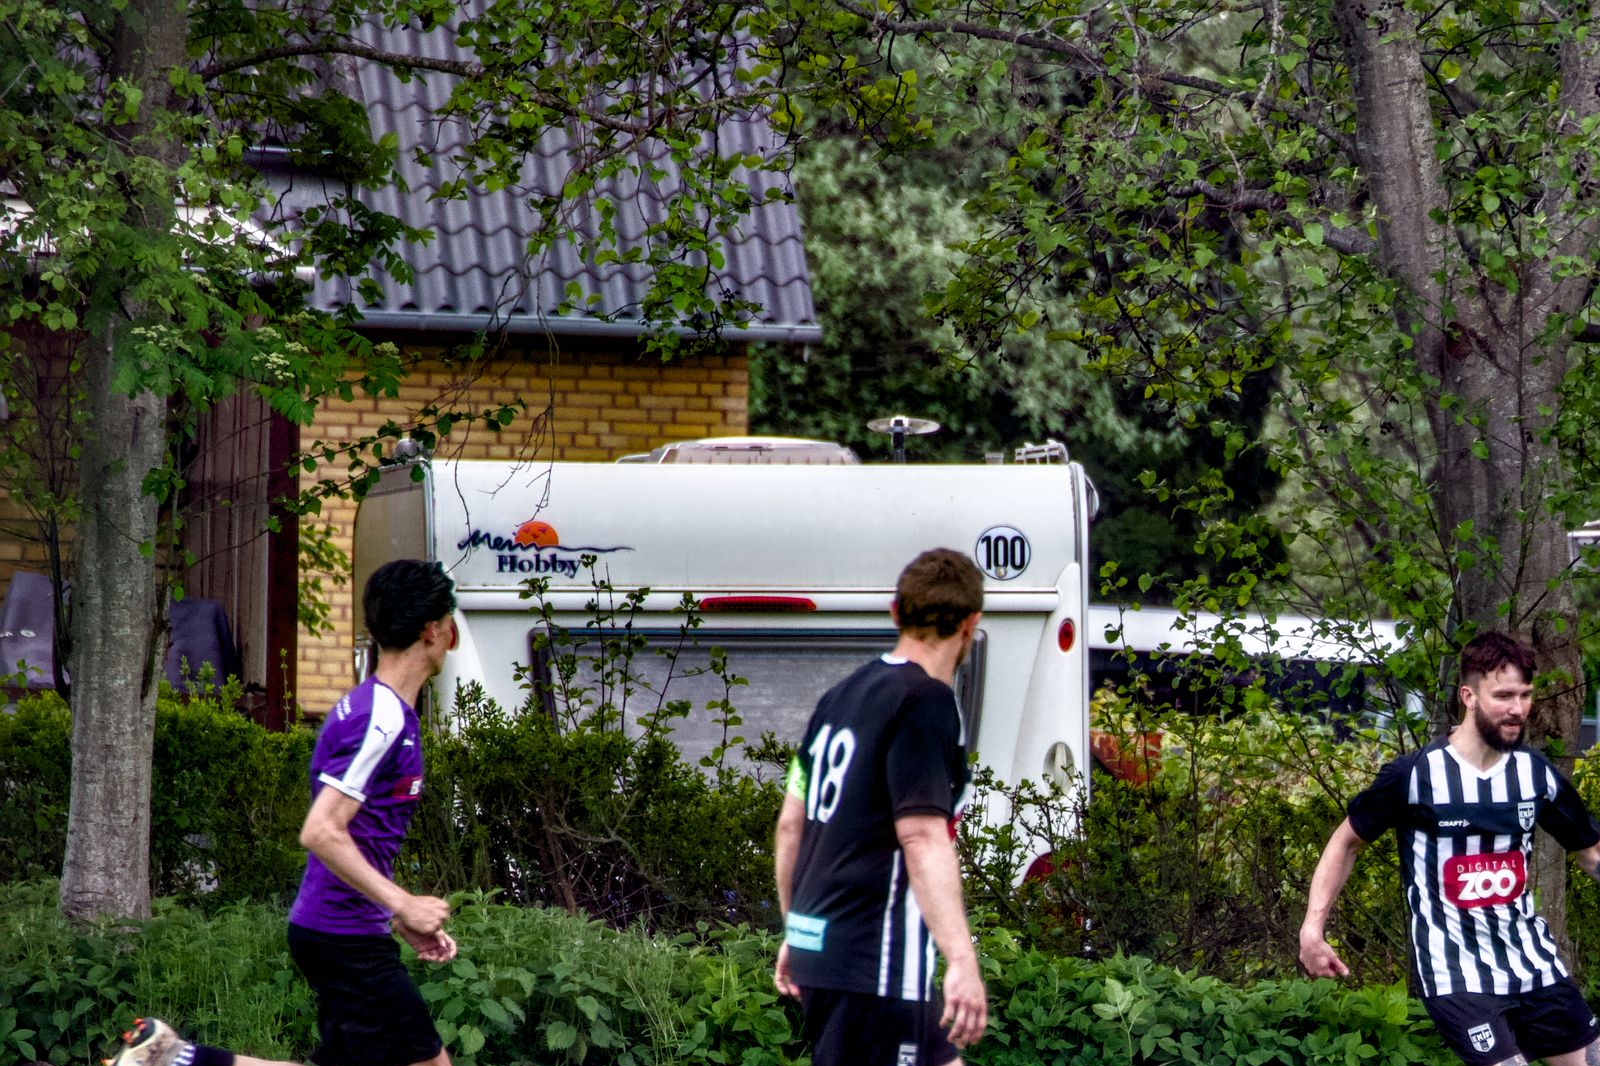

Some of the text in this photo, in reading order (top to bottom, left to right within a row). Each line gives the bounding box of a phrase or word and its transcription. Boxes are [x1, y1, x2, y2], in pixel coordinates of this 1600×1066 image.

[497, 553, 581, 579] Hobby
[981, 535, 1025, 571] 100
[808, 723, 855, 824] 18
[1438, 820, 1463, 828] CRAFT
[1457, 859, 1517, 874] DIGITAL
[1457, 869, 1517, 901] ZOO
